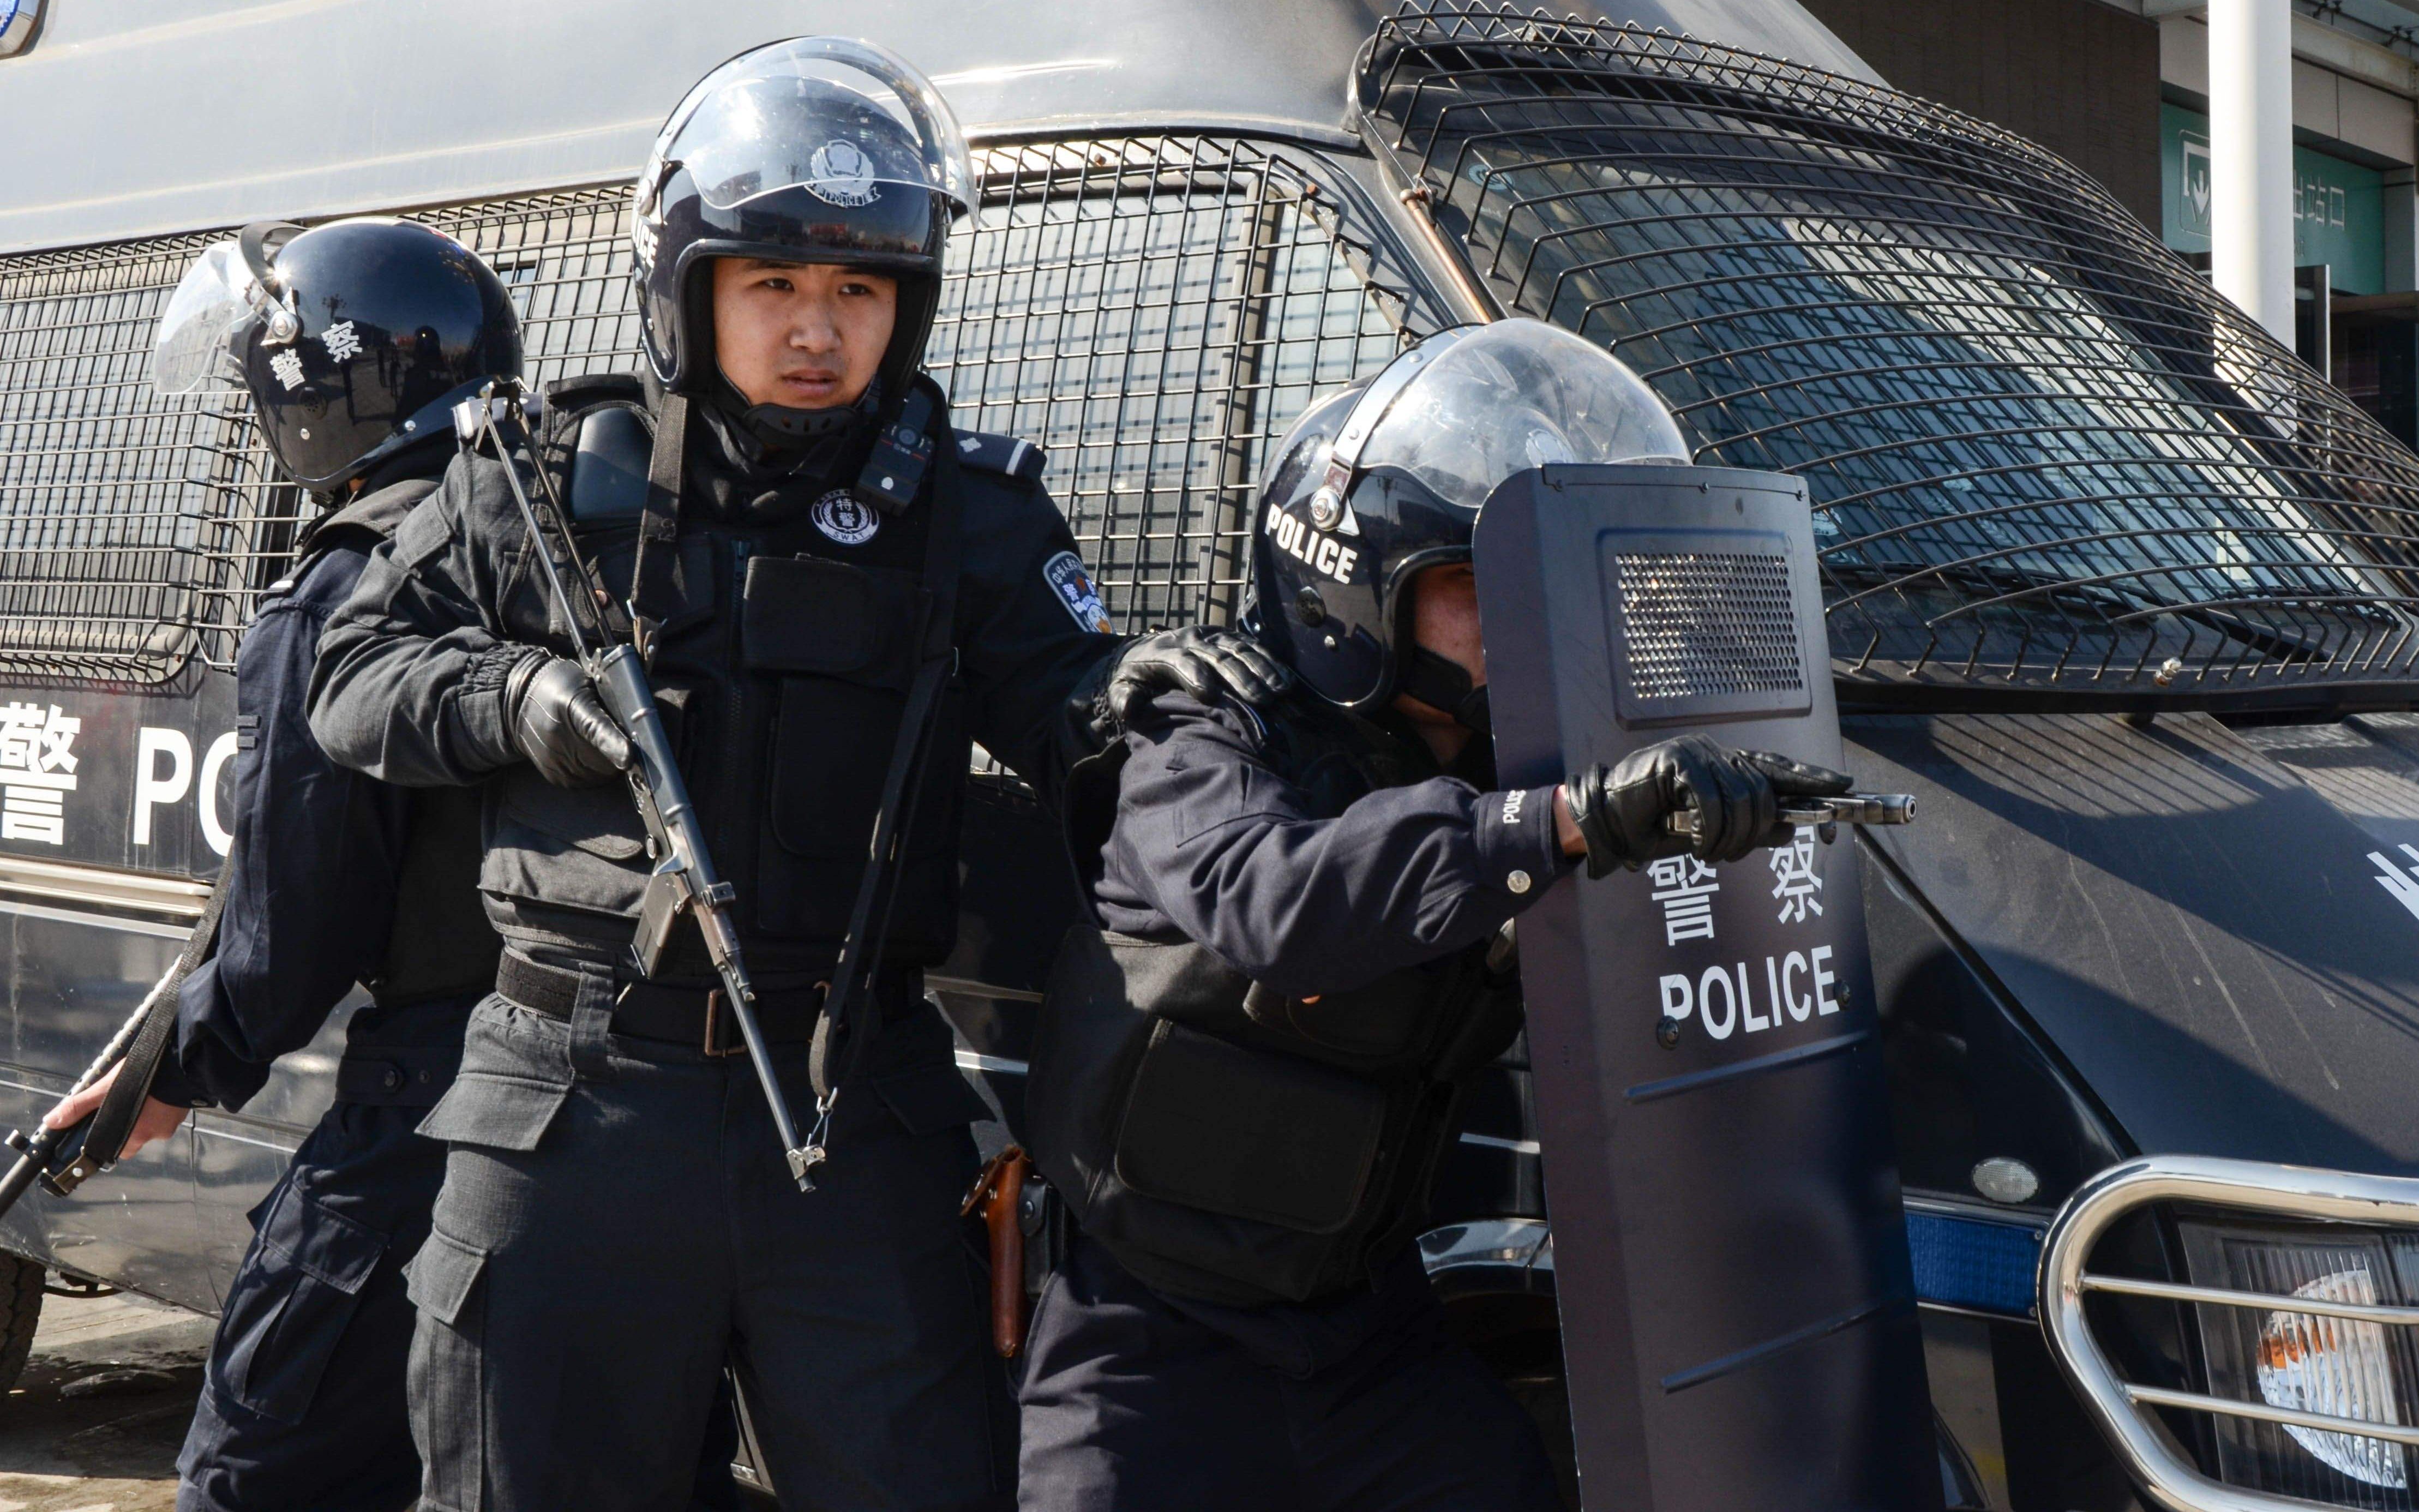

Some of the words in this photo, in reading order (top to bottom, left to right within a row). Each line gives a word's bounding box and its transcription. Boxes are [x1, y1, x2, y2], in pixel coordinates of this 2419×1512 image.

[829, 193, 860, 205] POLICE
[833, 531, 865, 541] SWAT
[835, 497, 856, 527] 特警
[1265, 503, 1358, 585] POLICE
[0, 702, 81, 845] 警
[1659, 945, 1840, 1040] POLICE
